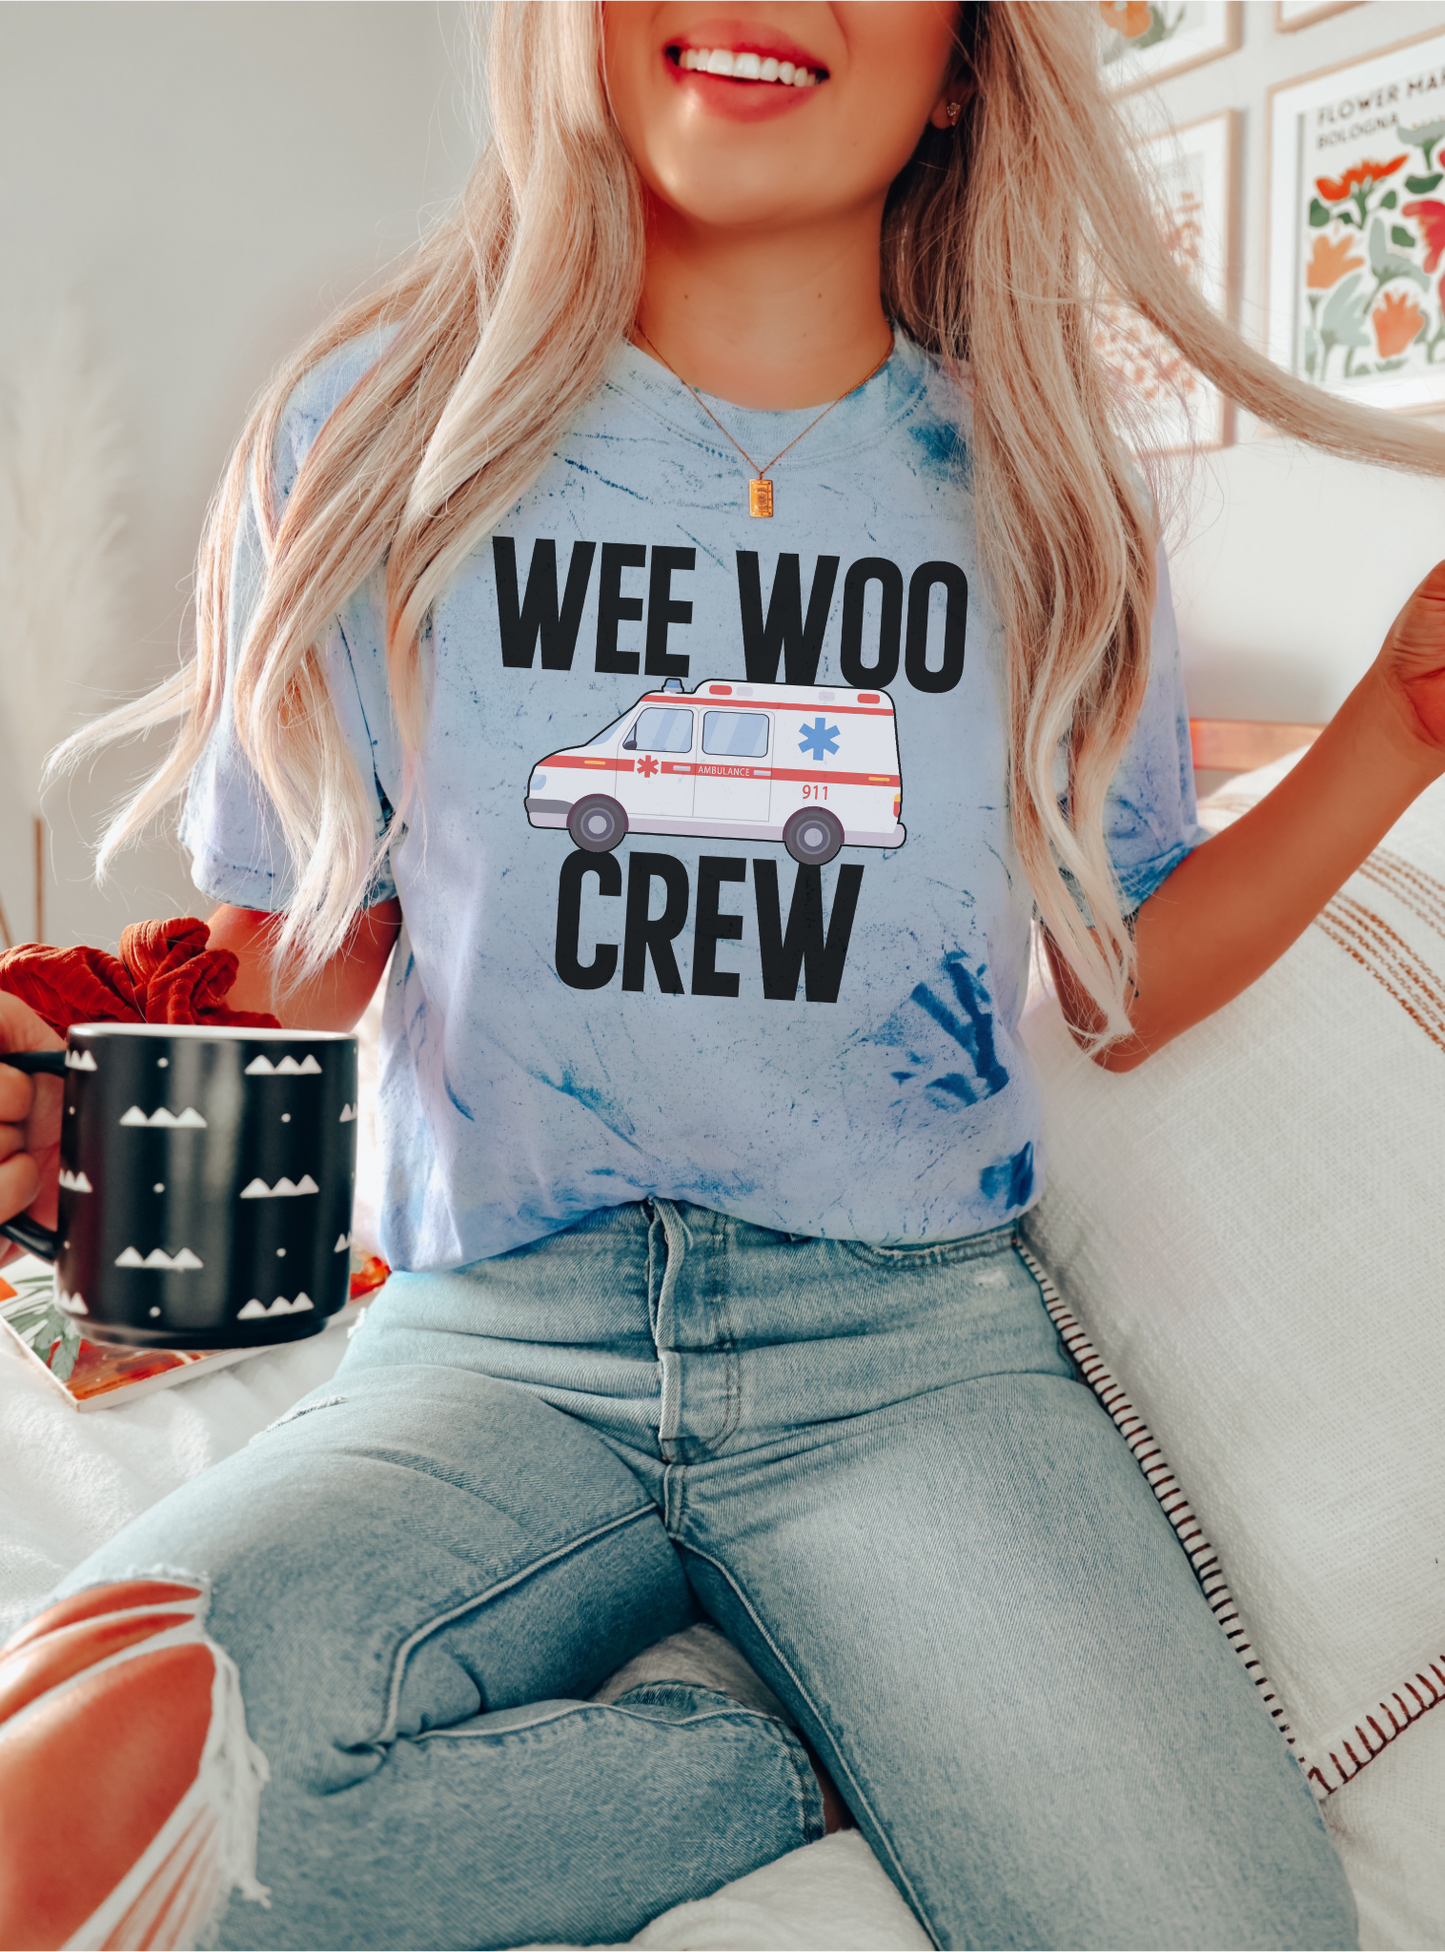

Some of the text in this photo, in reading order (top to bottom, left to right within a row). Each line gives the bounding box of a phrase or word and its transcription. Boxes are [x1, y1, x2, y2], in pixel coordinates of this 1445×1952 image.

[1317, 84, 1399, 127] FLOWER
[1317, 112, 1398, 149] BOLOGNA
[493, 536, 968, 693] WEE WOO
[697, 765, 750, 777] AMBULANCE
[802, 784, 828, 800] 911
[555, 849, 864, 1003] CREW
